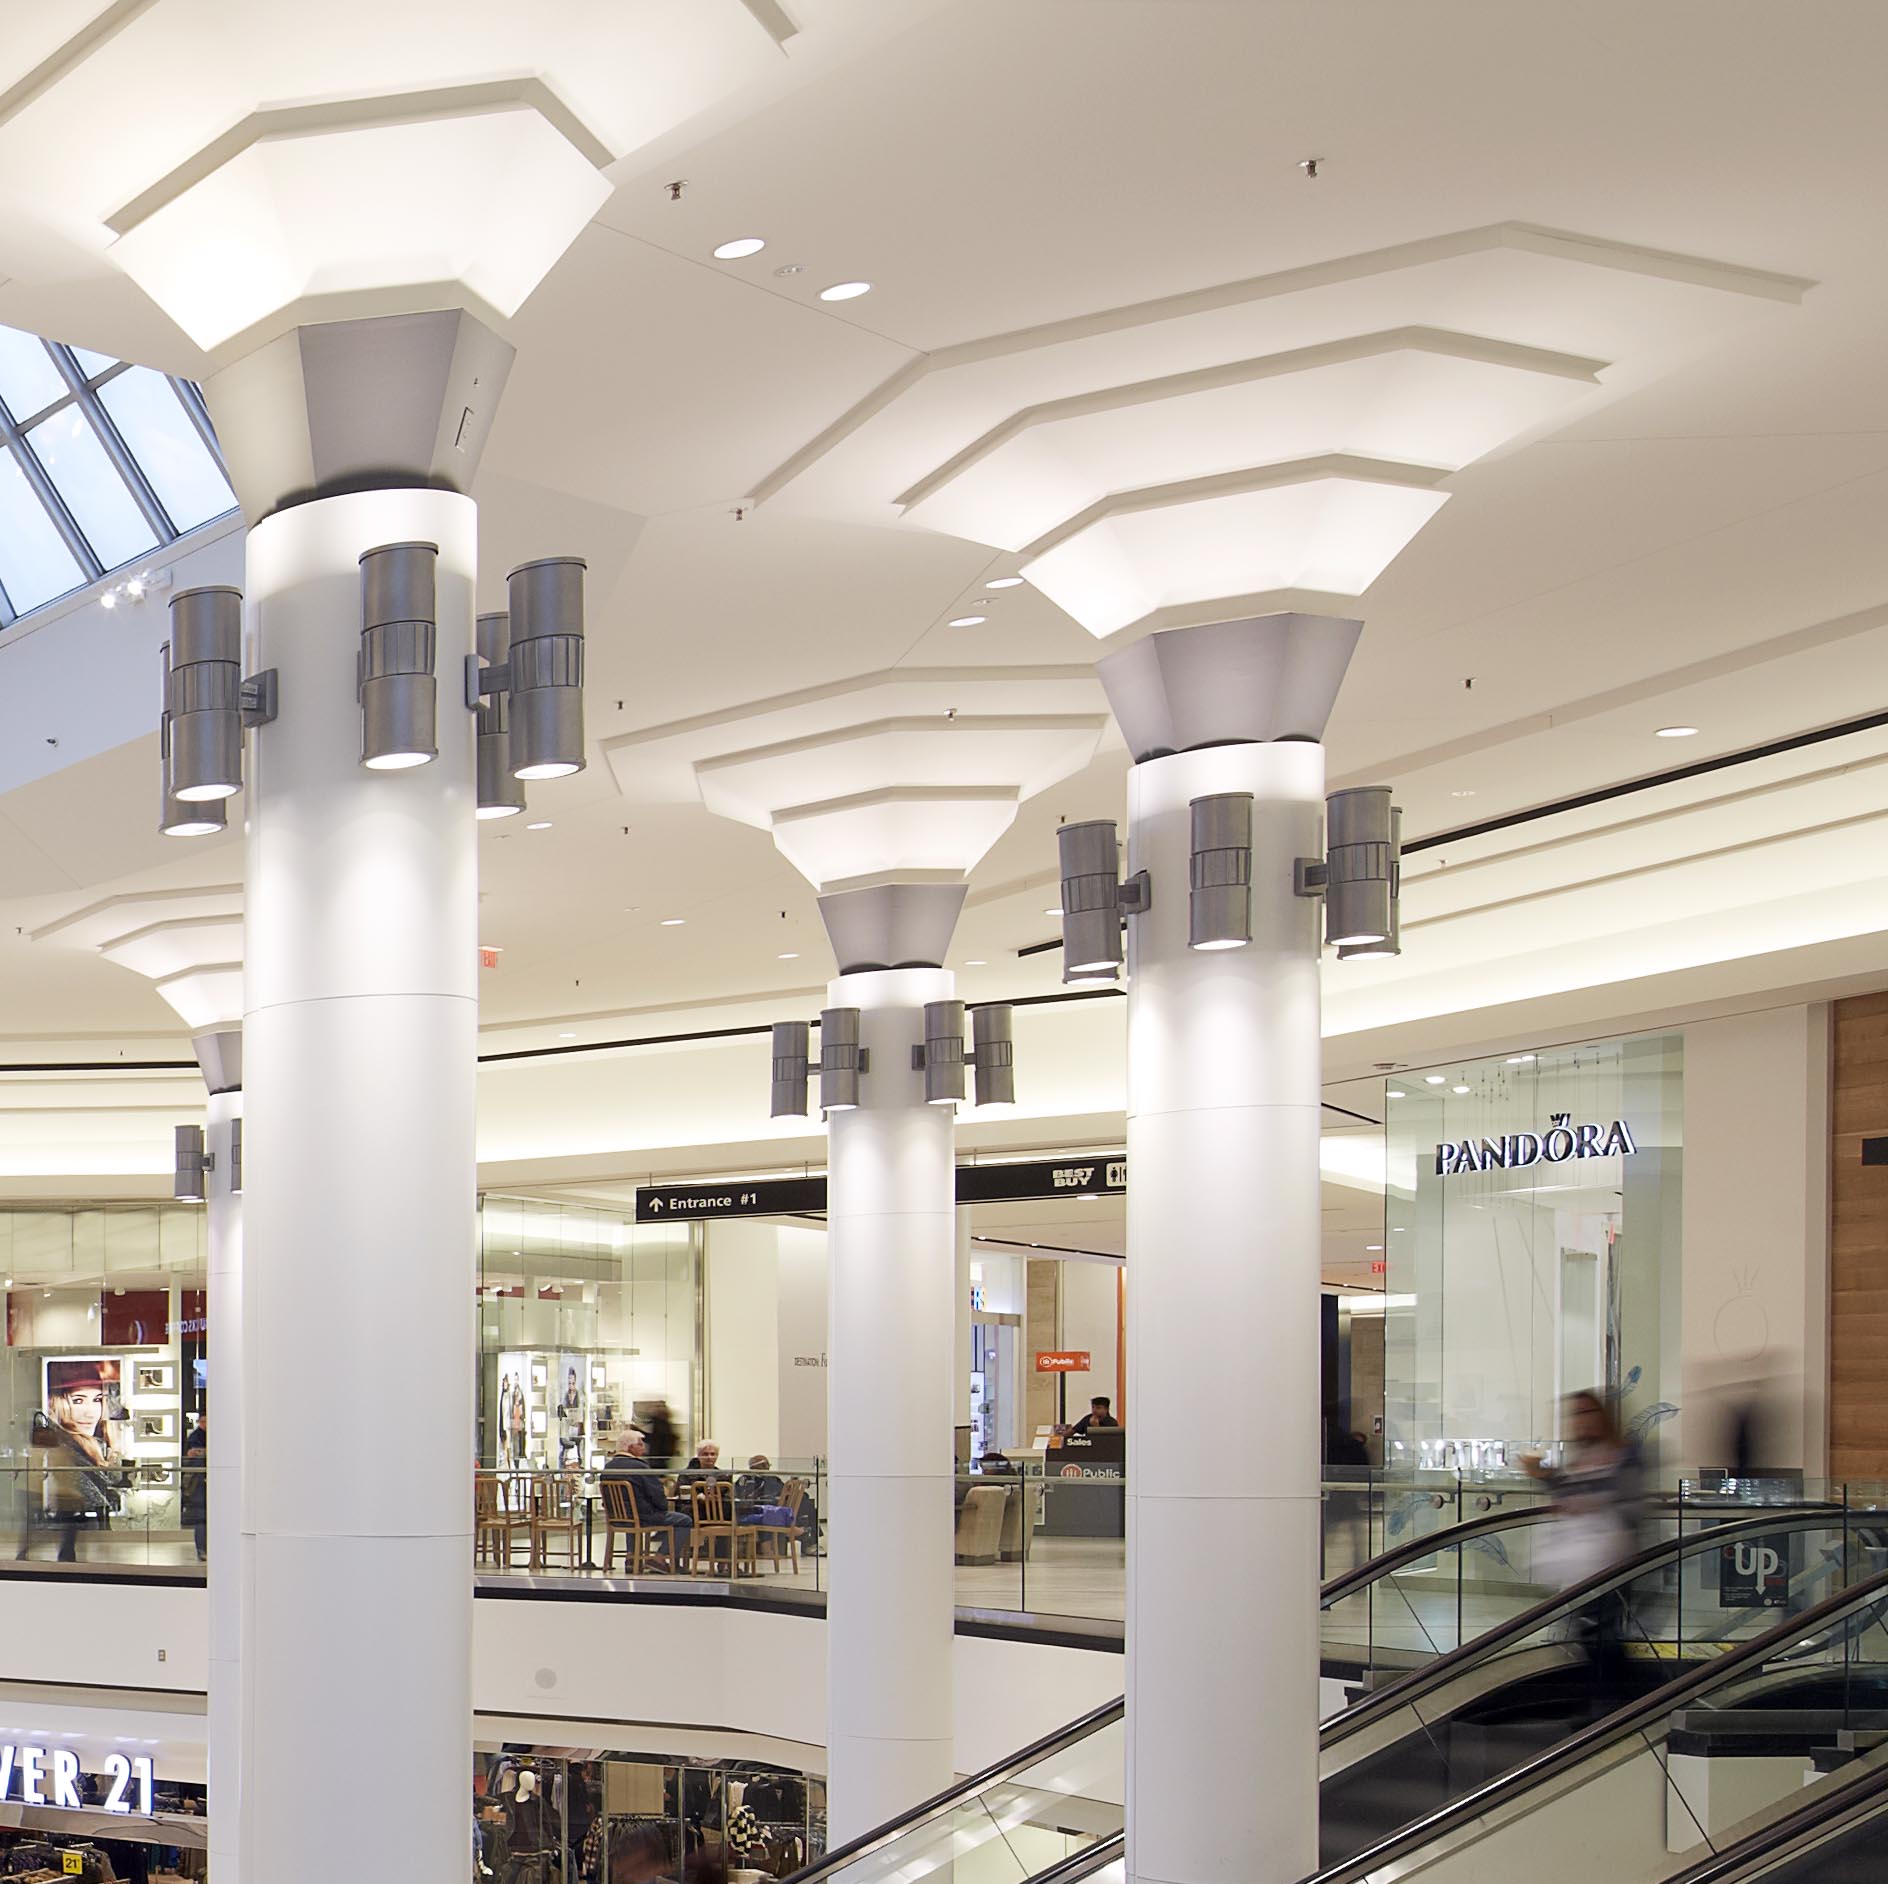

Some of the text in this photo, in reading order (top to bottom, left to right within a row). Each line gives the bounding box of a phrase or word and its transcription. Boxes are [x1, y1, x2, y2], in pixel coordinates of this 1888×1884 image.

[1435, 1119, 1638, 1176] PANDORA
[1052, 1168, 1095, 1179] BEST
[1054, 1177, 1091, 1187] BUY
[669, 1193, 757, 1210] Entrance #1
[1067, 1438, 1092, 1446] Sales
[103, 1753, 154, 1816] 21
